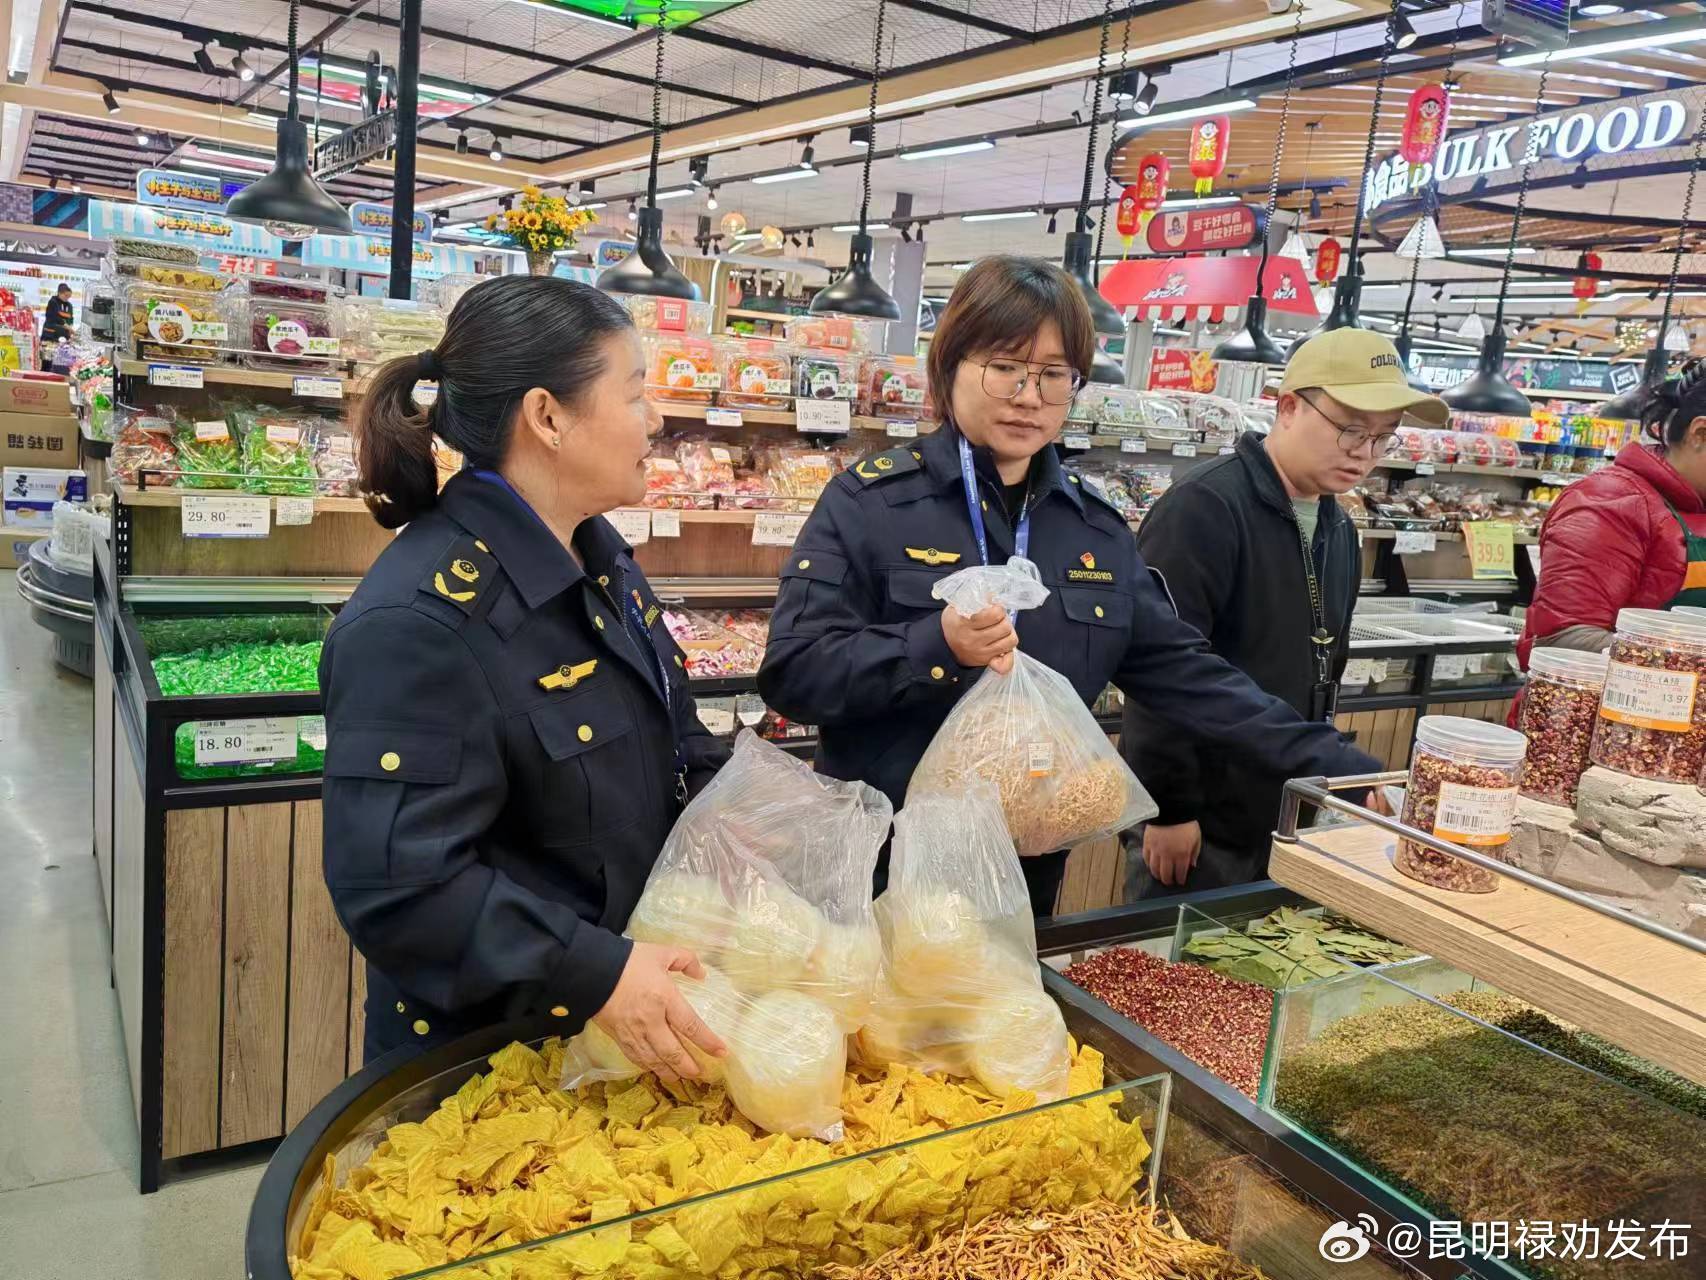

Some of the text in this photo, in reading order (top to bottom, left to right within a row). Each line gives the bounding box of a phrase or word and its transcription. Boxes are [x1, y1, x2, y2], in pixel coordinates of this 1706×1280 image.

[1519, 99, 1687, 166] FOOD
[188, 511, 226, 522] 29.80
[1478, 543, 1505, 563] 39.9
[200, 736, 242, 751] 18.80
